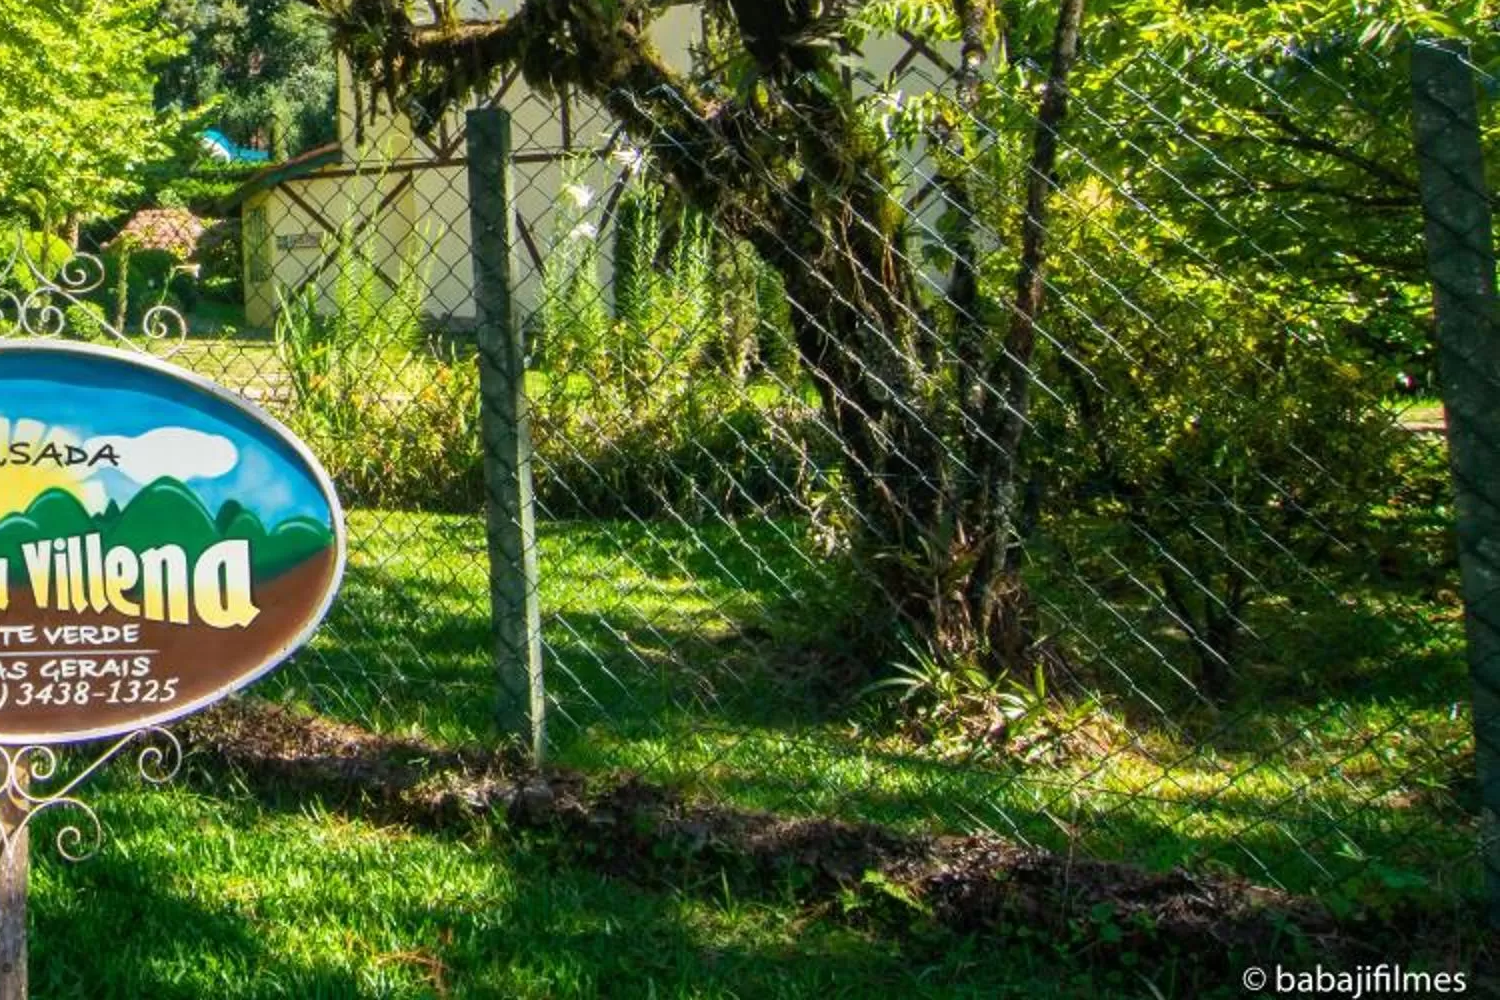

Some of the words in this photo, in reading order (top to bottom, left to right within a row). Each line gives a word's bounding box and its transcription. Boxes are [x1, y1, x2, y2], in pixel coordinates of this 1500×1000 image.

[21, 534, 261, 629] Villena
[43, 622, 140, 645] VERDE
[39, 656, 151, 681] GERAIS
[15, 679, 178, 706] 3438-1325
